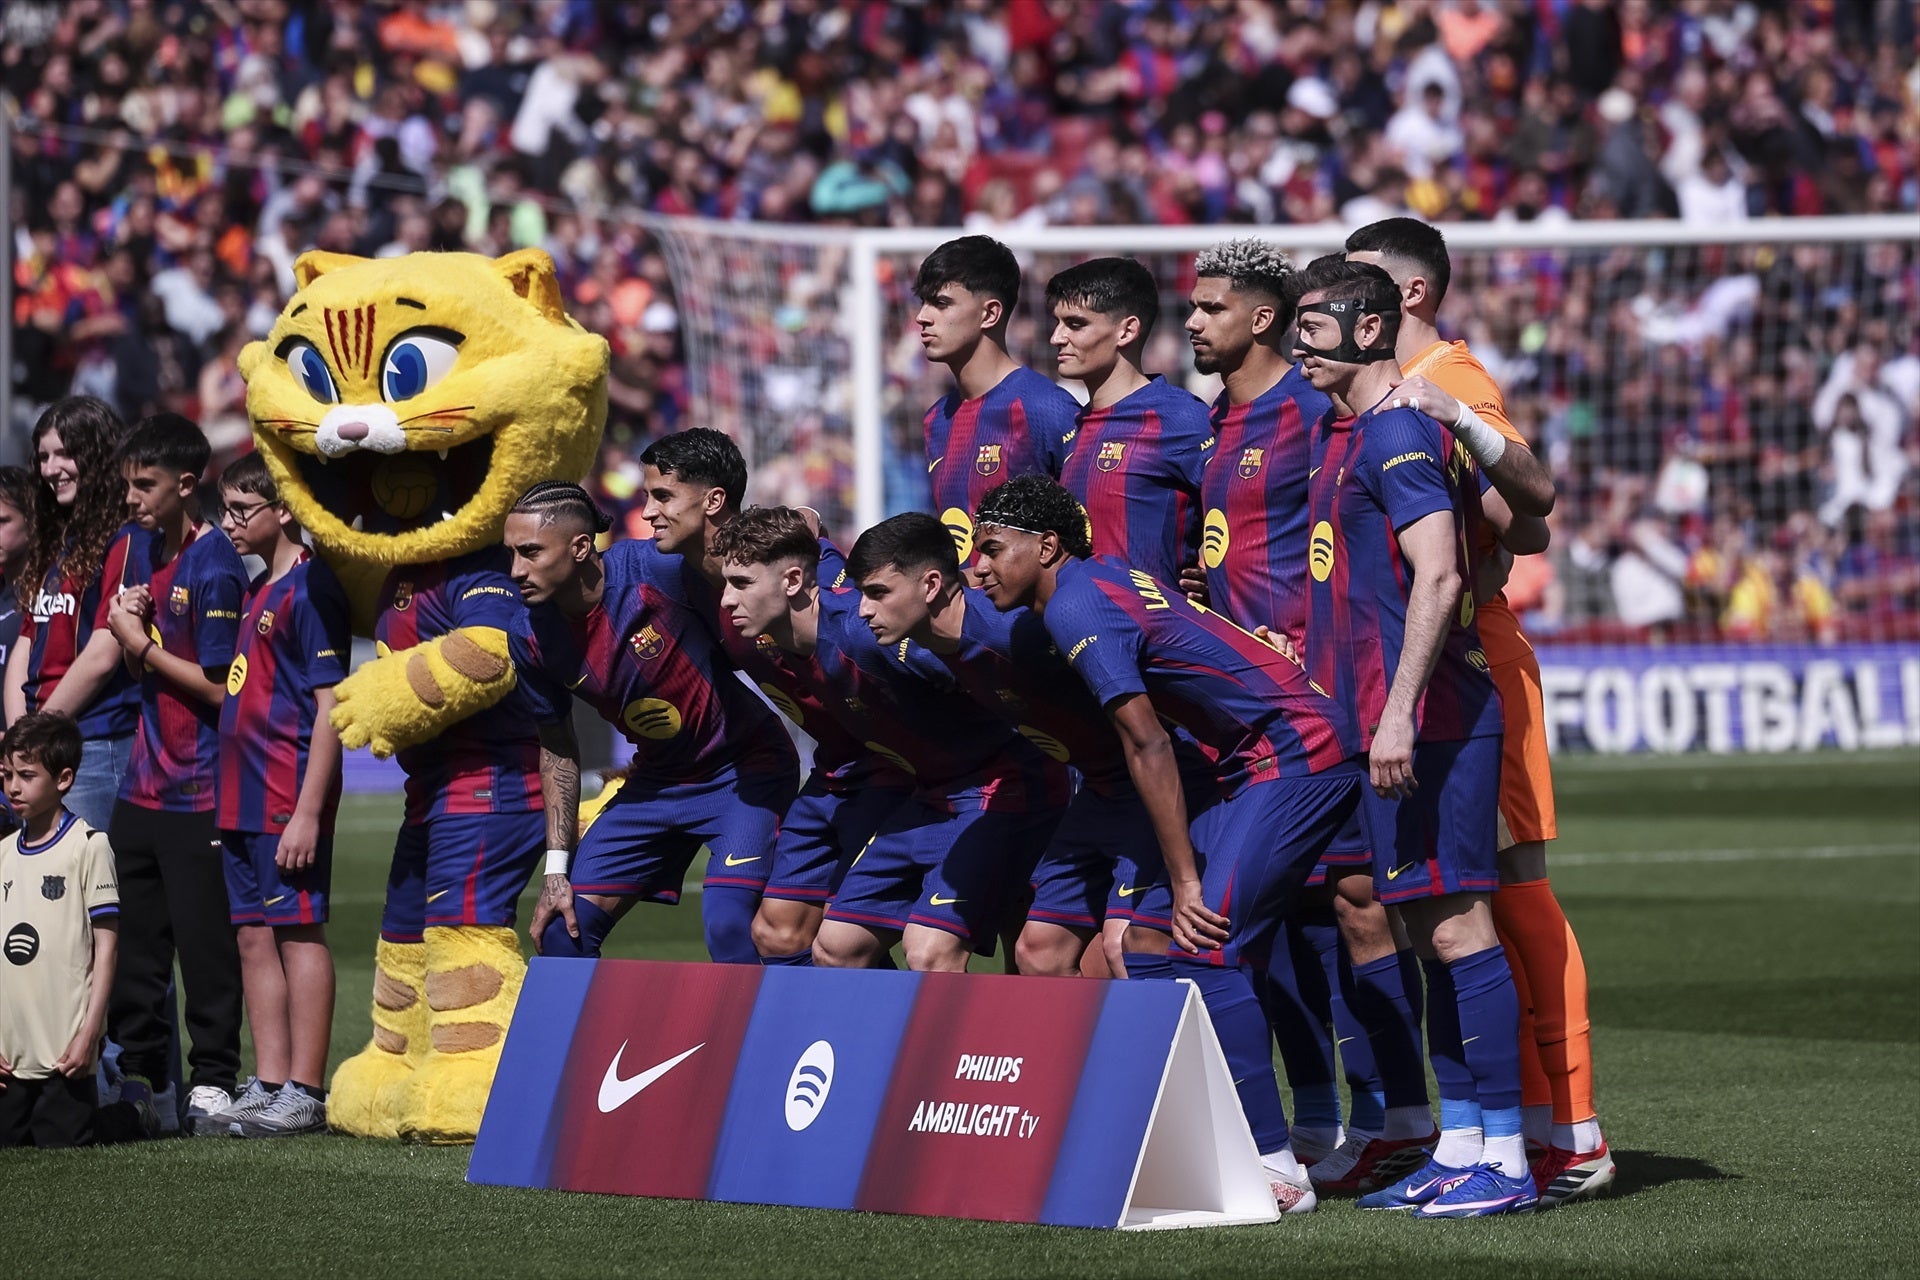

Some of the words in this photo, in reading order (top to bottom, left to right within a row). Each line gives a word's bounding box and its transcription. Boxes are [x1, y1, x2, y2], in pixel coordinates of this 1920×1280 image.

[1330, 303, 1346, 312] RL9
[1382, 451, 1426, 472] AMBILIGHT
[462, 586, 504, 601] AMBILIGHT
[954, 1054, 1023, 1083] PHILIPS
[908, 1100, 1020, 1137] AMBILIGHT
[1018, 1109, 1040, 1139] tv
